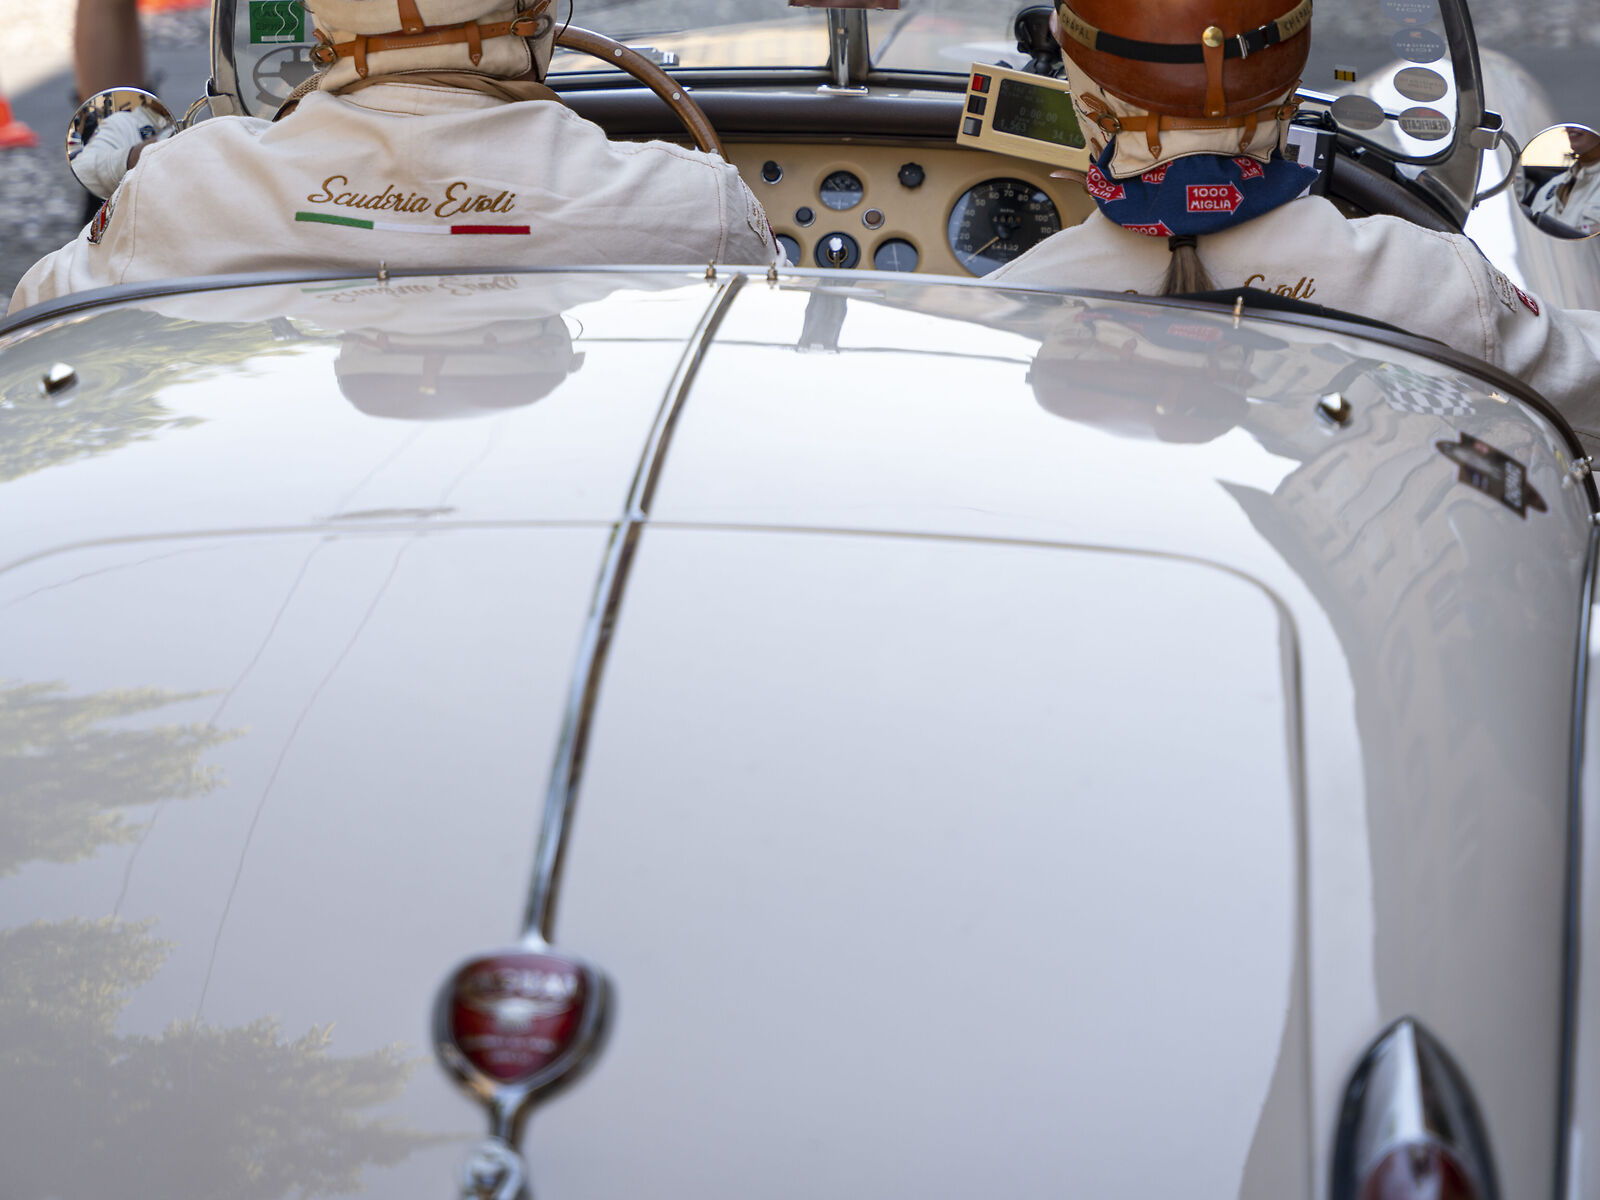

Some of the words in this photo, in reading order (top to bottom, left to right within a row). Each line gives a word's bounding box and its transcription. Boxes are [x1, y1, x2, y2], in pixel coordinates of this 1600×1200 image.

[307, 175, 431, 213] Scuderia
[434, 181, 516, 218] Evoli
[1193, 188, 1228, 198] 1000
[1191, 200, 1231, 210] MIGLIA
